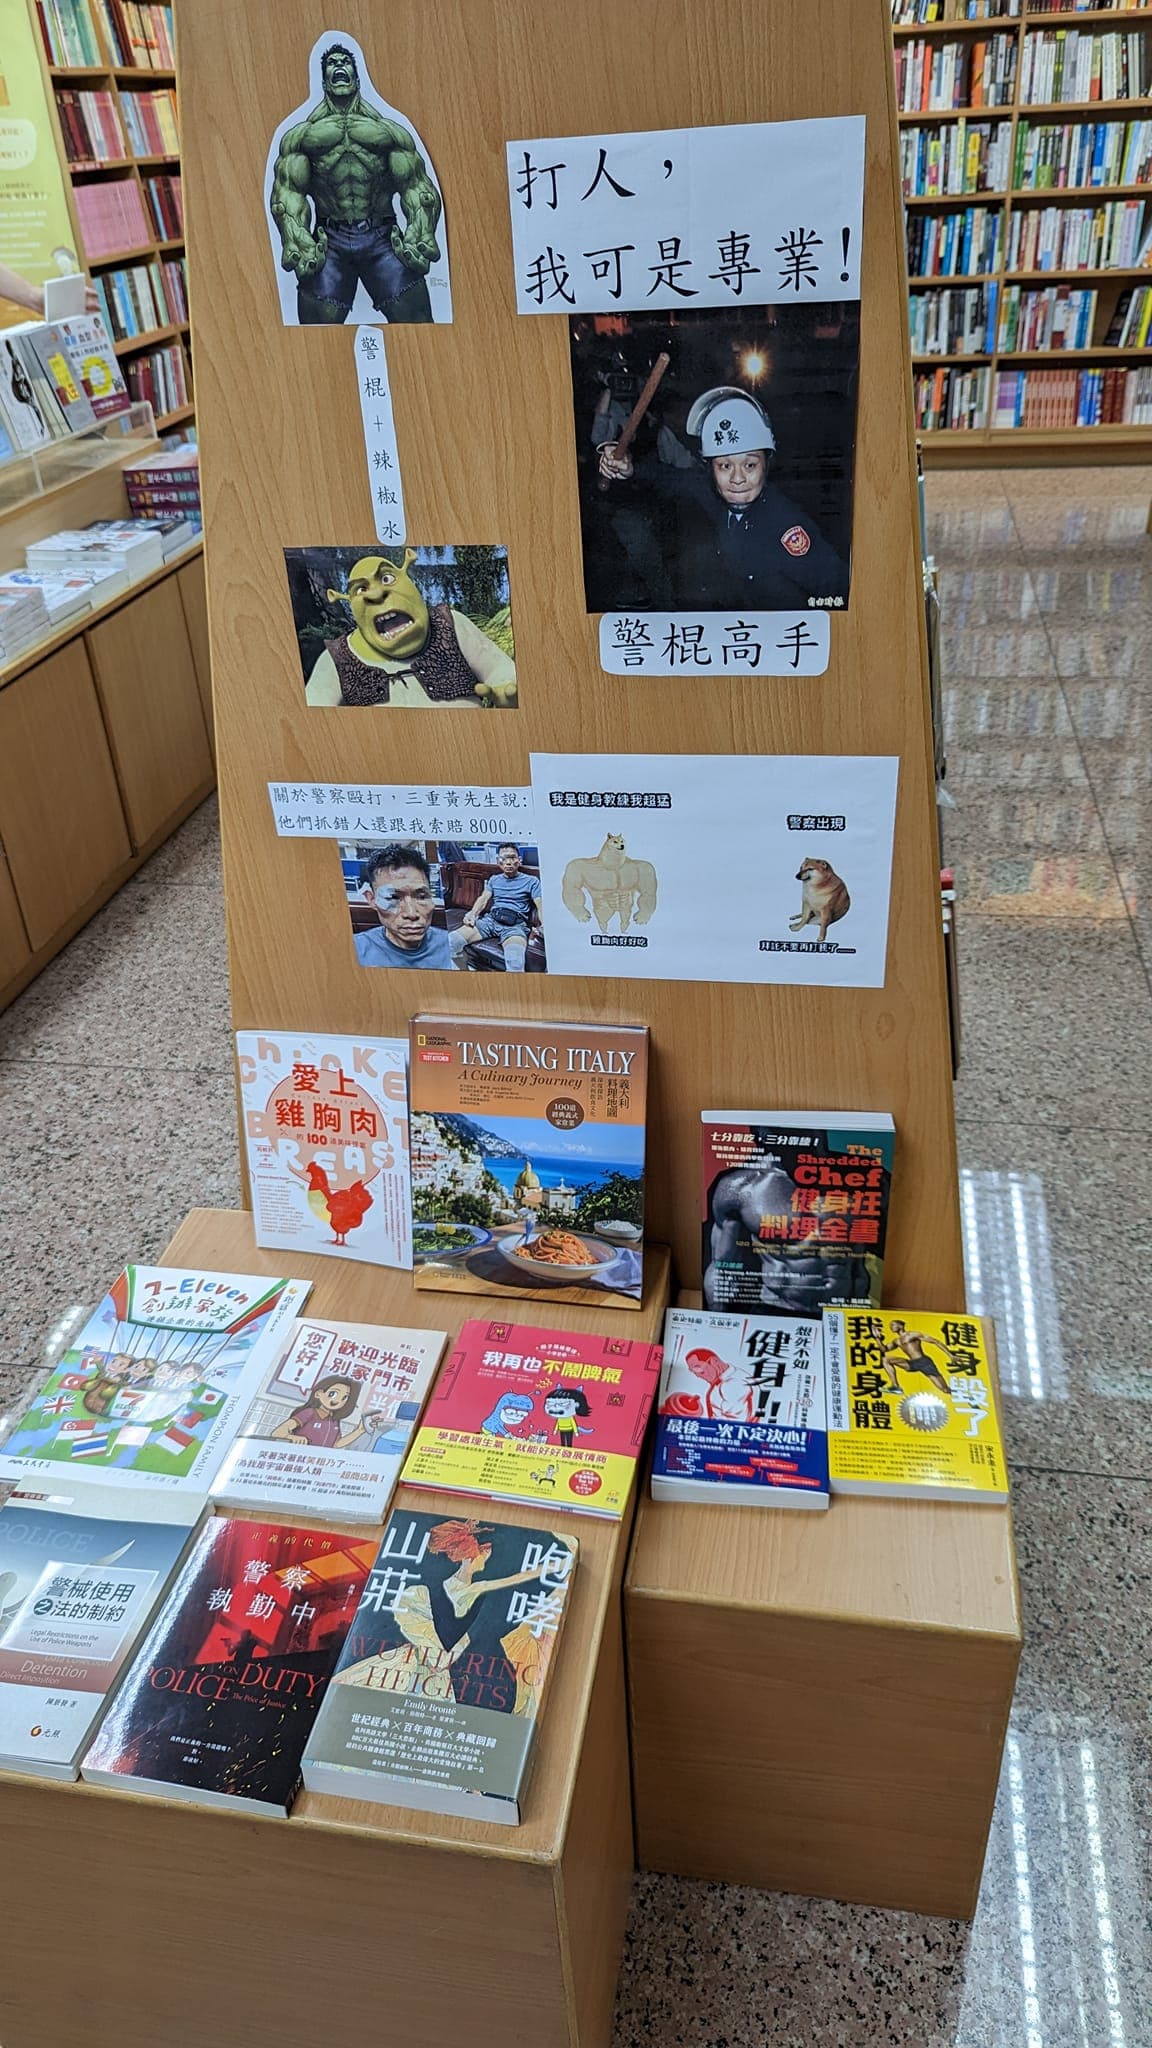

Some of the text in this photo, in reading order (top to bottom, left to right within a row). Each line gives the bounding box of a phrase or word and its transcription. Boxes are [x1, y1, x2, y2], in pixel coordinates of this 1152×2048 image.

[515, 148, 675, 210] 打人，
[611, 617, 820, 669] 警棍高手
[550, 792, 671, 809] 我是健身教練我超猛
[278, 815, 464, 834] 他們抓錯人還跟我索賠
[787, 815, 846, 831] 警察出現
[457, 1041, 636, 1075] TASTING ITALY
[291, 1063, 358, 1099] 愛上
[457, 1069, 583, 1090] A Culinary Journey
[619, 1079, 630, 1110] 義大利
[606, 1078, 618, 1118] 料理地圖
[274, 1098, 378, 1138] 雞胸肉
[797, 1154, 882, 1167] Shredded
[847, 1144, 882, 1156] The
[794, 1166, 882, 1188] Chef
[790, 1187, 882, 1216] 健身狂
[759, 1213, 880, 1244] 料理全書
[144, 1277, 250, 1305] 7-Eleven
[141, 1295, 234, 1322] 創辦家族
[336, 1338, 421, 1375] 歡迎光臨
[847, 1315, 893, 1431] 我的身體
[329, 1357, 414, 1392] 別家門市
[941, 1320, 989, 1438] 健身毀了
[193, 1395, 240, 1478] THOMPSON FAMILY
[242, 1558, 311, 1595] 警察
[357, 1521, 432, 1614] 山莊
[47, 1575, 137, 1603] 警械使用
[506, 1542, 574, 1639] 咆哮
[206, 1587, 317, 1626] 執勤中
[30, 1628, 47, 1637] Legal
[47, 1629, 79, 1640] Restrictions
[47, 1637, 66, 1645] Police
[66, 1638, 92, 1648] Weapons
[0, 1670, 22, 1680] Direct
[20, 1659, 88, 1679] Detention
[351, 1636, 544, 1688] WUTHERING
[223, 1665, 240, 1675] ON
[239, 1663, 327, 1698] DUTY
[362, 1665, 512, 1709] HEIGHTS
[403, 1699, 428, 1712] Emily
[351, 1713, 390, 1729] 世紀經典
[403, 1721, 444, 1739] 百年商務
[456, 1731, 498, 1749] 典藏回歸
